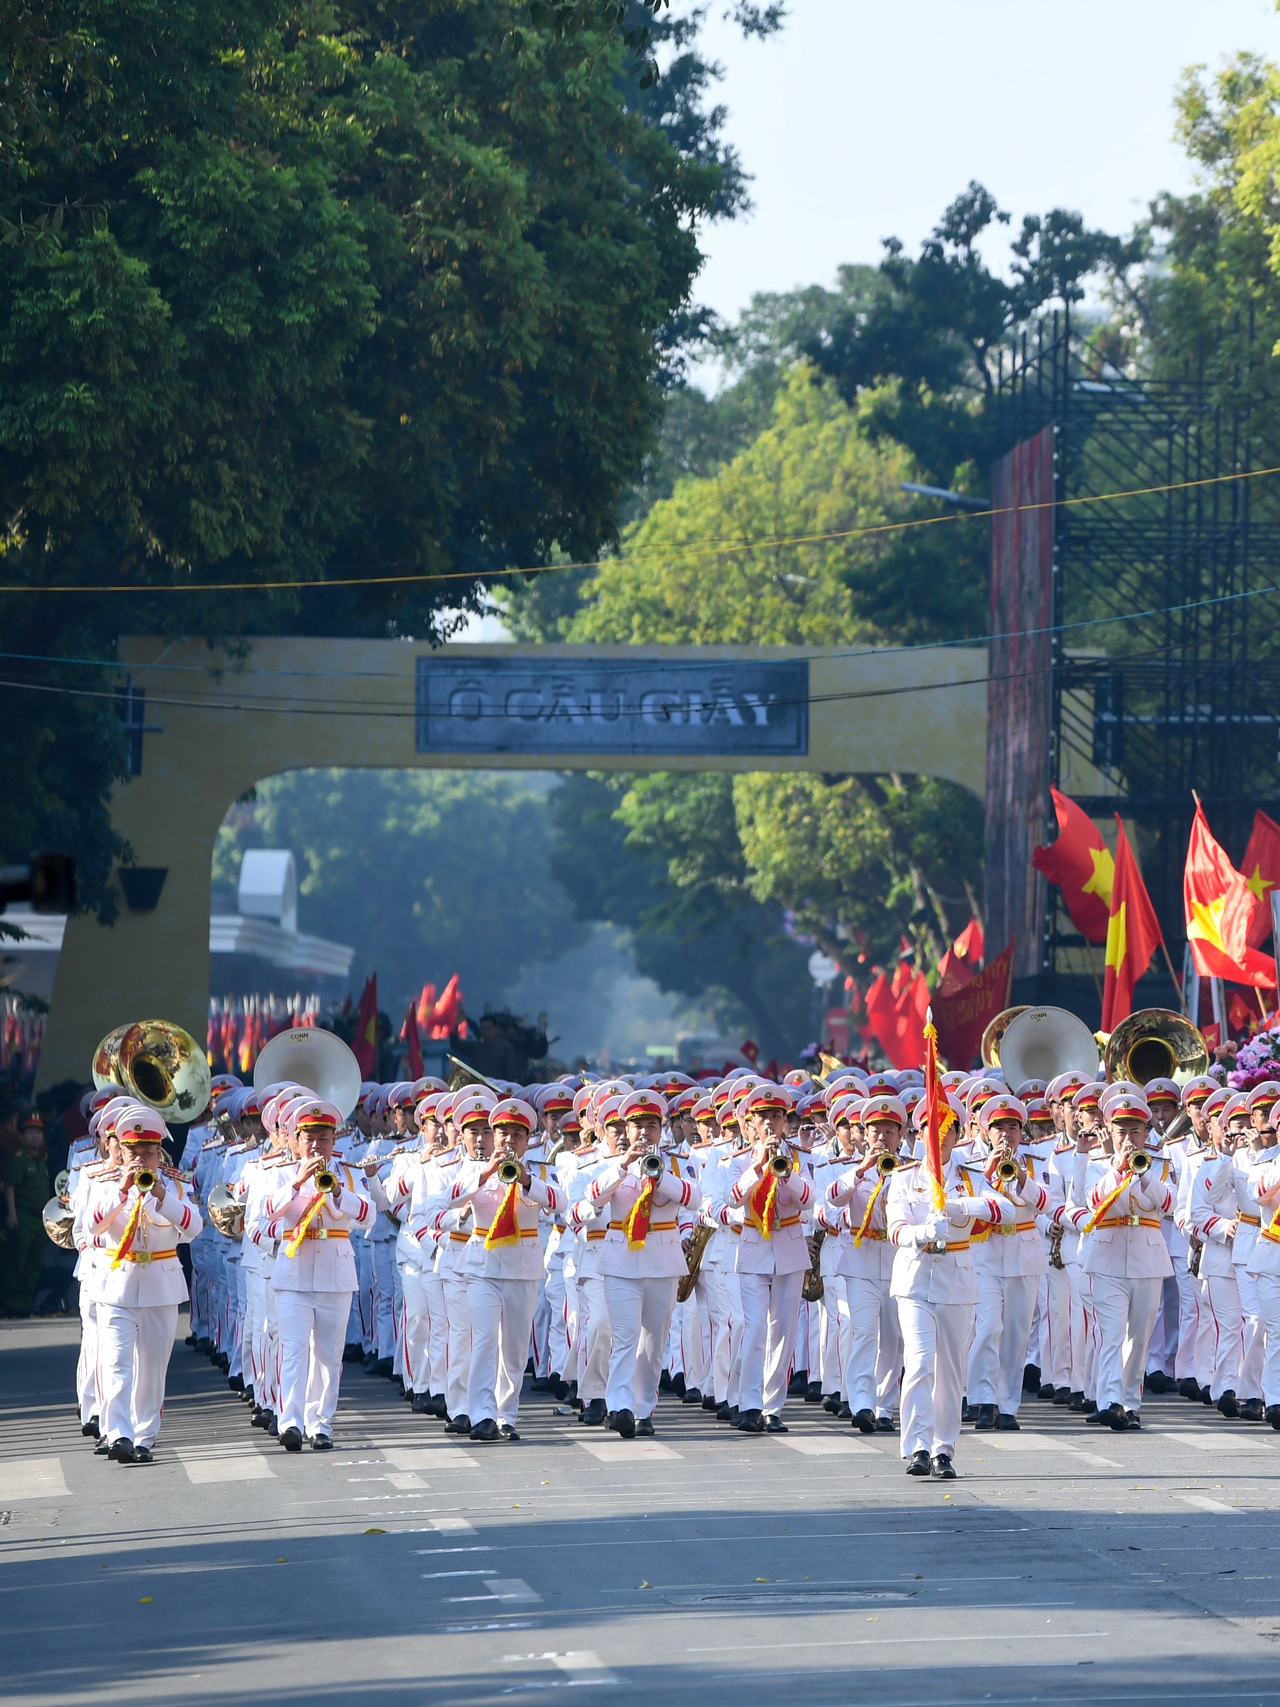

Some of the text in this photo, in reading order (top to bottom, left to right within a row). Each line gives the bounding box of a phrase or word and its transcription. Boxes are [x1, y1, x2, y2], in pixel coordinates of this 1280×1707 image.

[448, 674, 777, 726] Ô CẦU GIẤY
